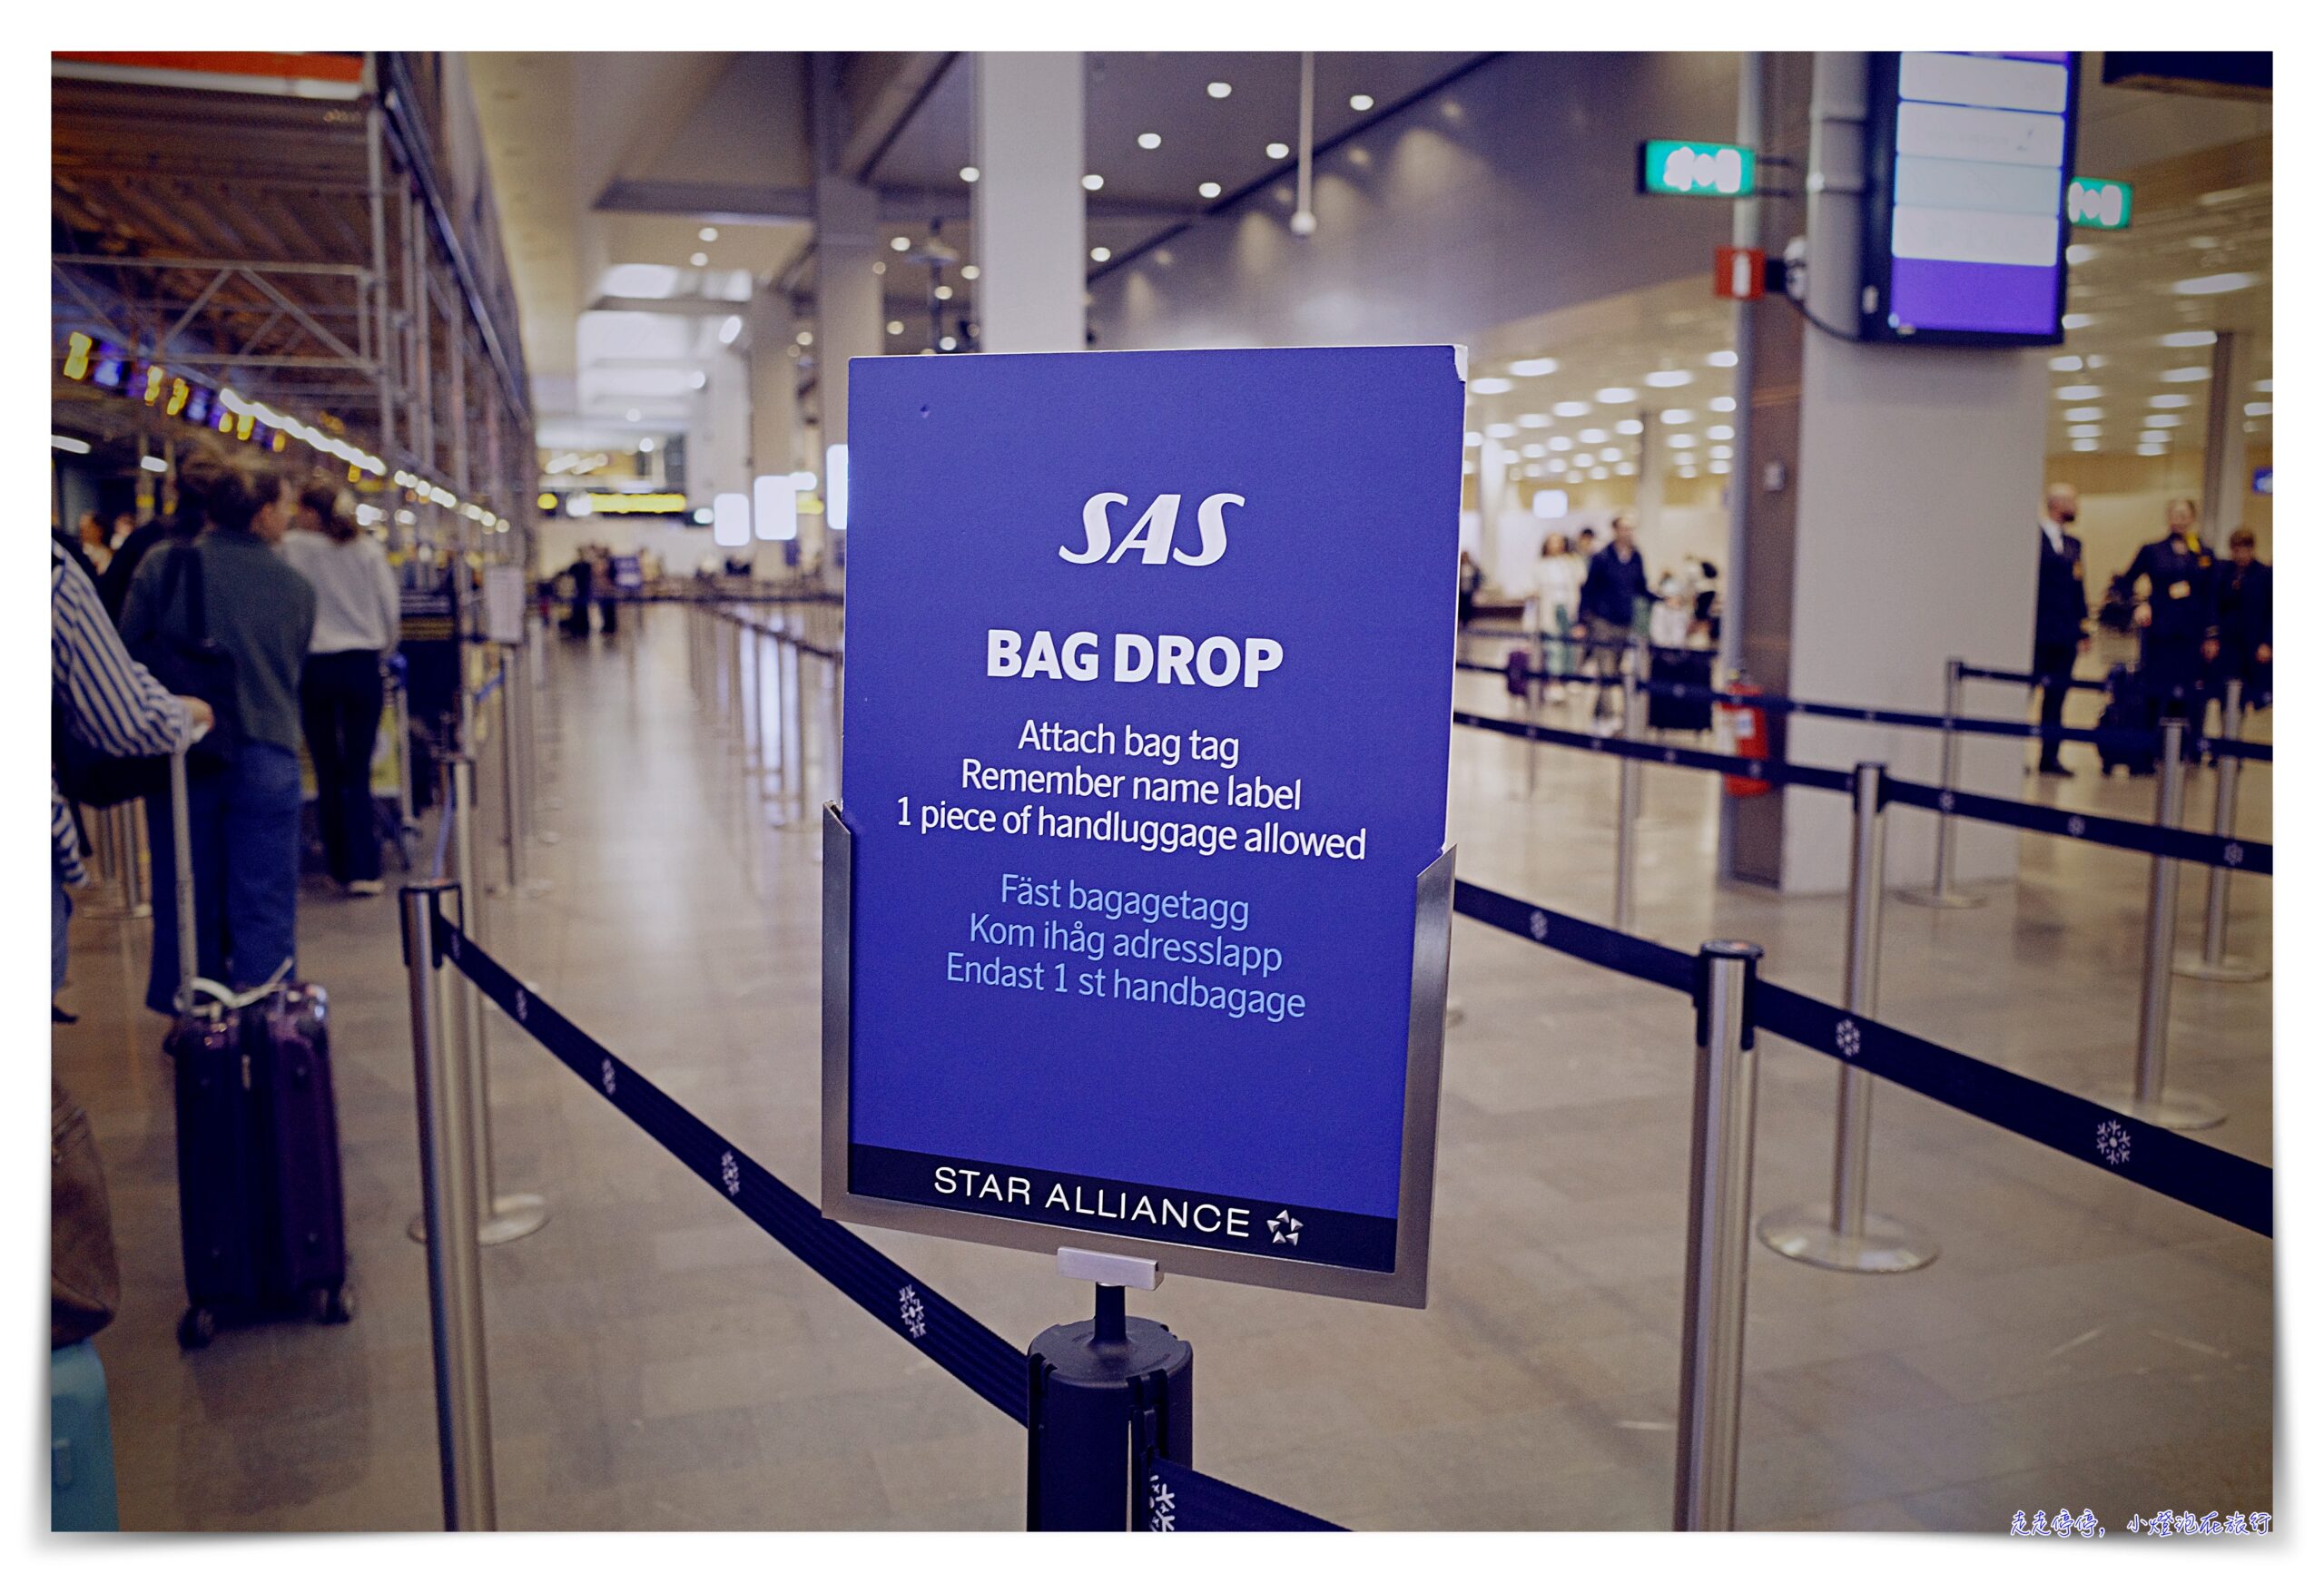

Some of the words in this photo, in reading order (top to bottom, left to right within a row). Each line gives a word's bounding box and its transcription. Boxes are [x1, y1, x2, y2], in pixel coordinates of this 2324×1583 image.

[1059, 493, 1245, 566] SAS
[987, 629, 1098, 682] BAG
[1114, 634, 1284, 688] DROP
[1018, 720, 1116, 756] Attach
[1124, 724, 1180, 766] bag
[1188, 730, 1239, 770] tag
[961, 759, 1126, 801] Remember
[1132, 777, 1219, 805] name
[1227, 775, 1302, 813] label
[897, 797, 911, 826] 1
[921, 801, 997, 835] piece
[1002, 804, 1033, 835] of
[1038, 806, 1237, 856] handluggage
[1244, 822, 1366, 860] allowed
[1001, 874, 1061, 909] Fäst
[1068, 880, 1249, 931] bagagetagg
[970, 913, 1035, 948] Kom
[1043, 918, 1105, 961] ihåg
[1113, 935, 1283, 978] adresslapp
[947, 952, 1045, 992] Endast
[1054, 964, 1068, 993] 1
[1078, 968, 1107, 998] st
[1114, 969, 1306, 1023] handbagage
[934, 1167, 1030, 1205] STAR
[1045, 1184, 1250, 1238] ALLIANCE
